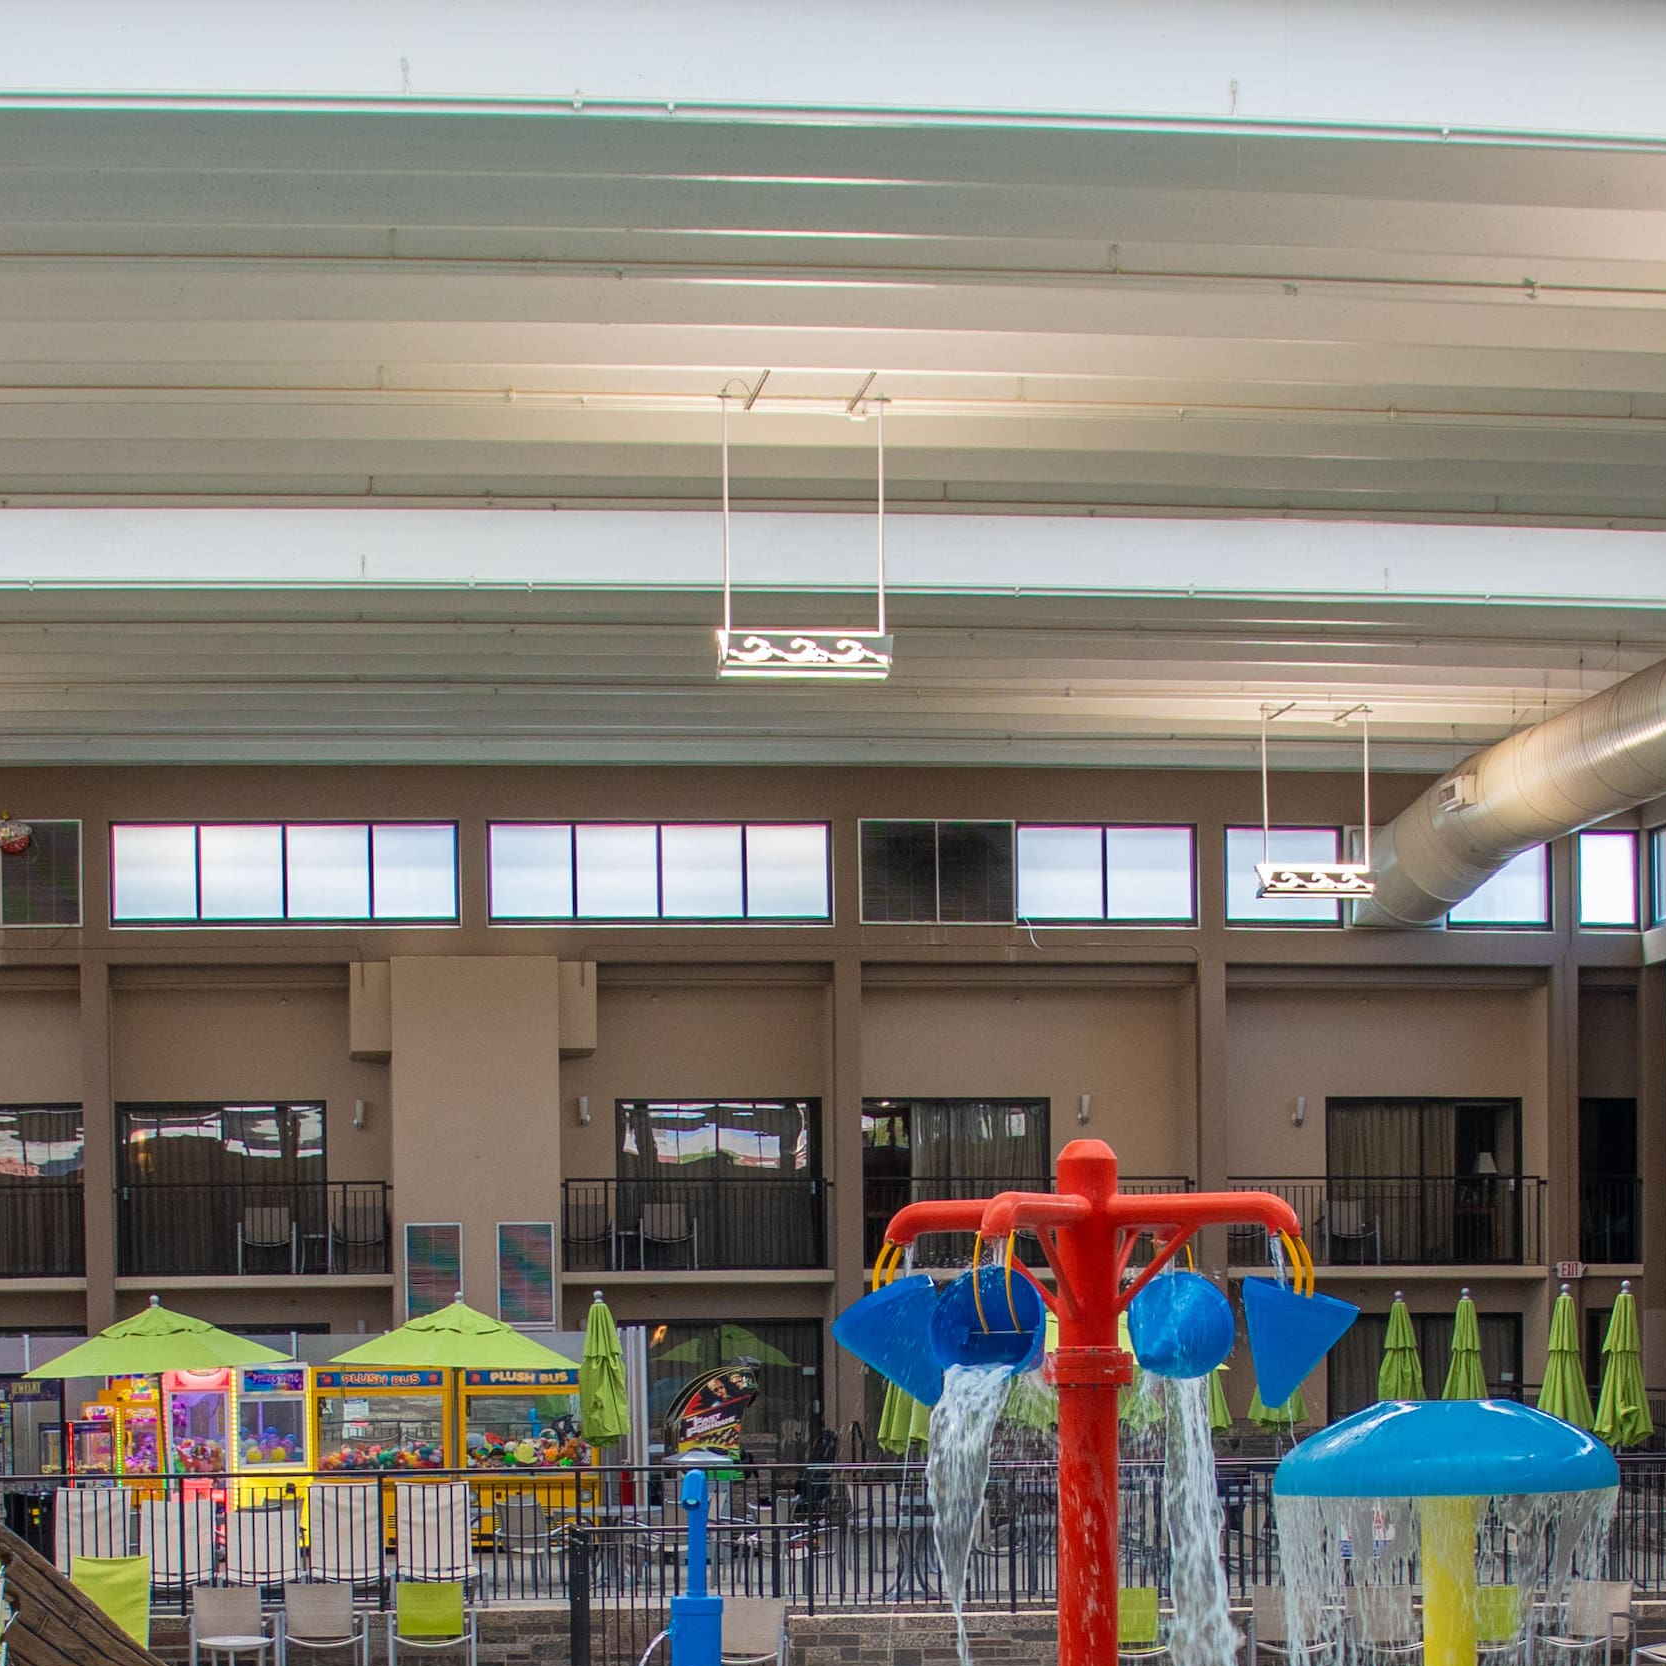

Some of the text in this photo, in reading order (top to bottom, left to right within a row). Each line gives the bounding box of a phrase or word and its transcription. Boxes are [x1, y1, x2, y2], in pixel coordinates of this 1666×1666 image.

[1562, 1263, 1579, 1276] EXIT
[342, 1373, 420, 1385] PLUSH BUS
[490, 1371, 568, 1384] PLUSH BUS
[686, 1412, 722, 1428] FAST
[686, 1415, 736, 1438] FURIOUS
